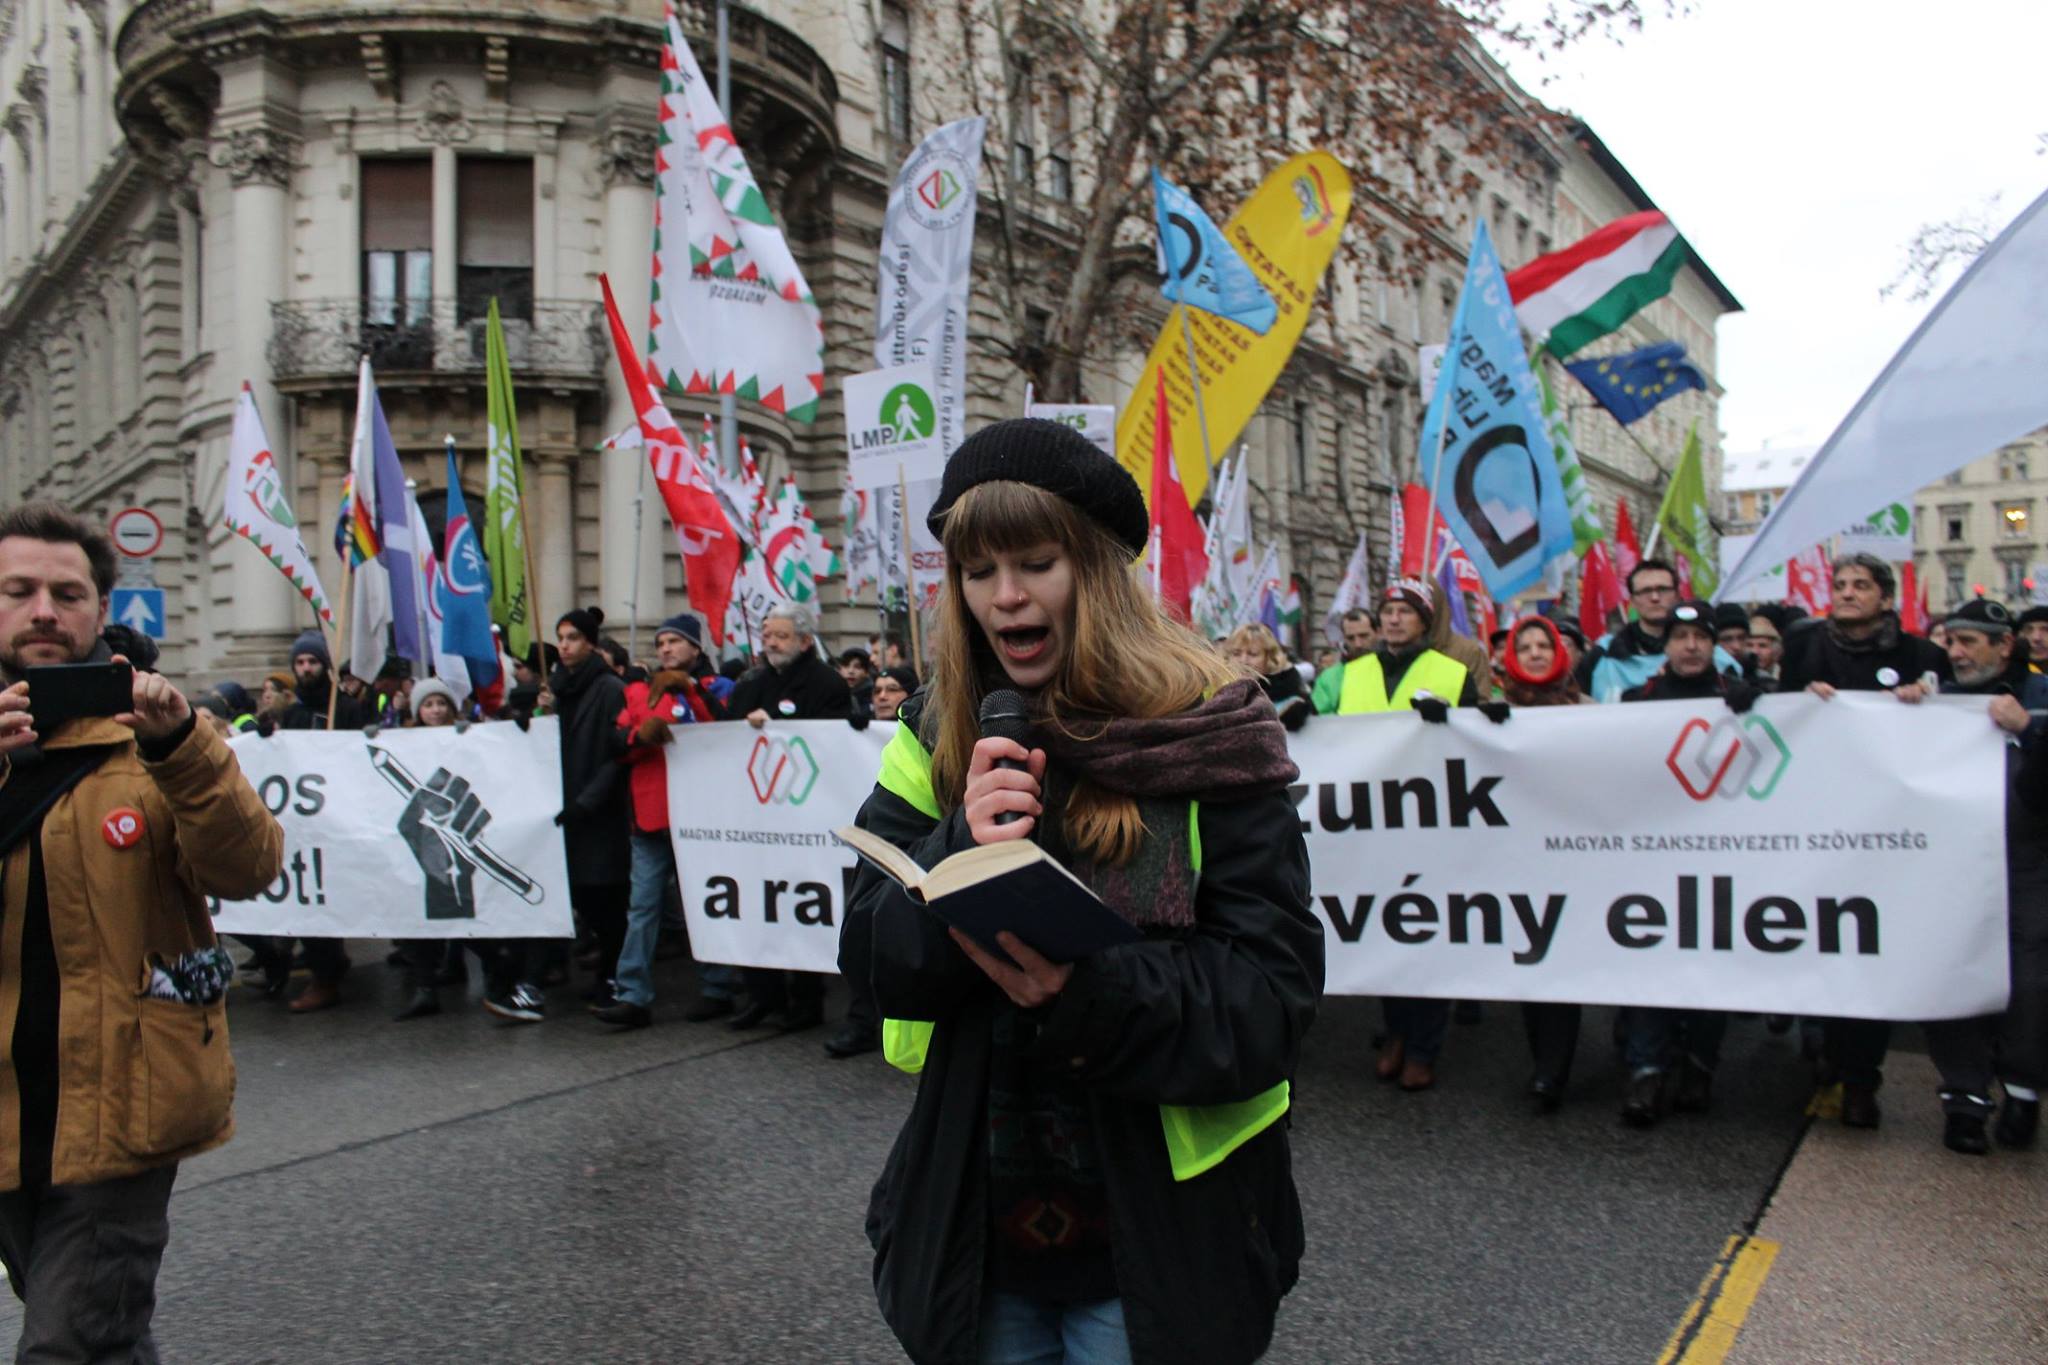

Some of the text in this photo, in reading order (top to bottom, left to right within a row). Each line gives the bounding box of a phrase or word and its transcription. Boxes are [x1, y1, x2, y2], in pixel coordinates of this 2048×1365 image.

[850, 426, 894, 451] LMP
[679, 828, 722, 843] MAGYAR
[725, 830, 827, 848] SZAKSZERVEZETI
[1545, 829, 1930, 852] MAGYAR SZAKSZERVEZETI SZÖVETSÉG
[703, 875, 741, 920] a
[1307, 873, 1568, 966] vény
[1606, 875, 1880, 955] ellen
